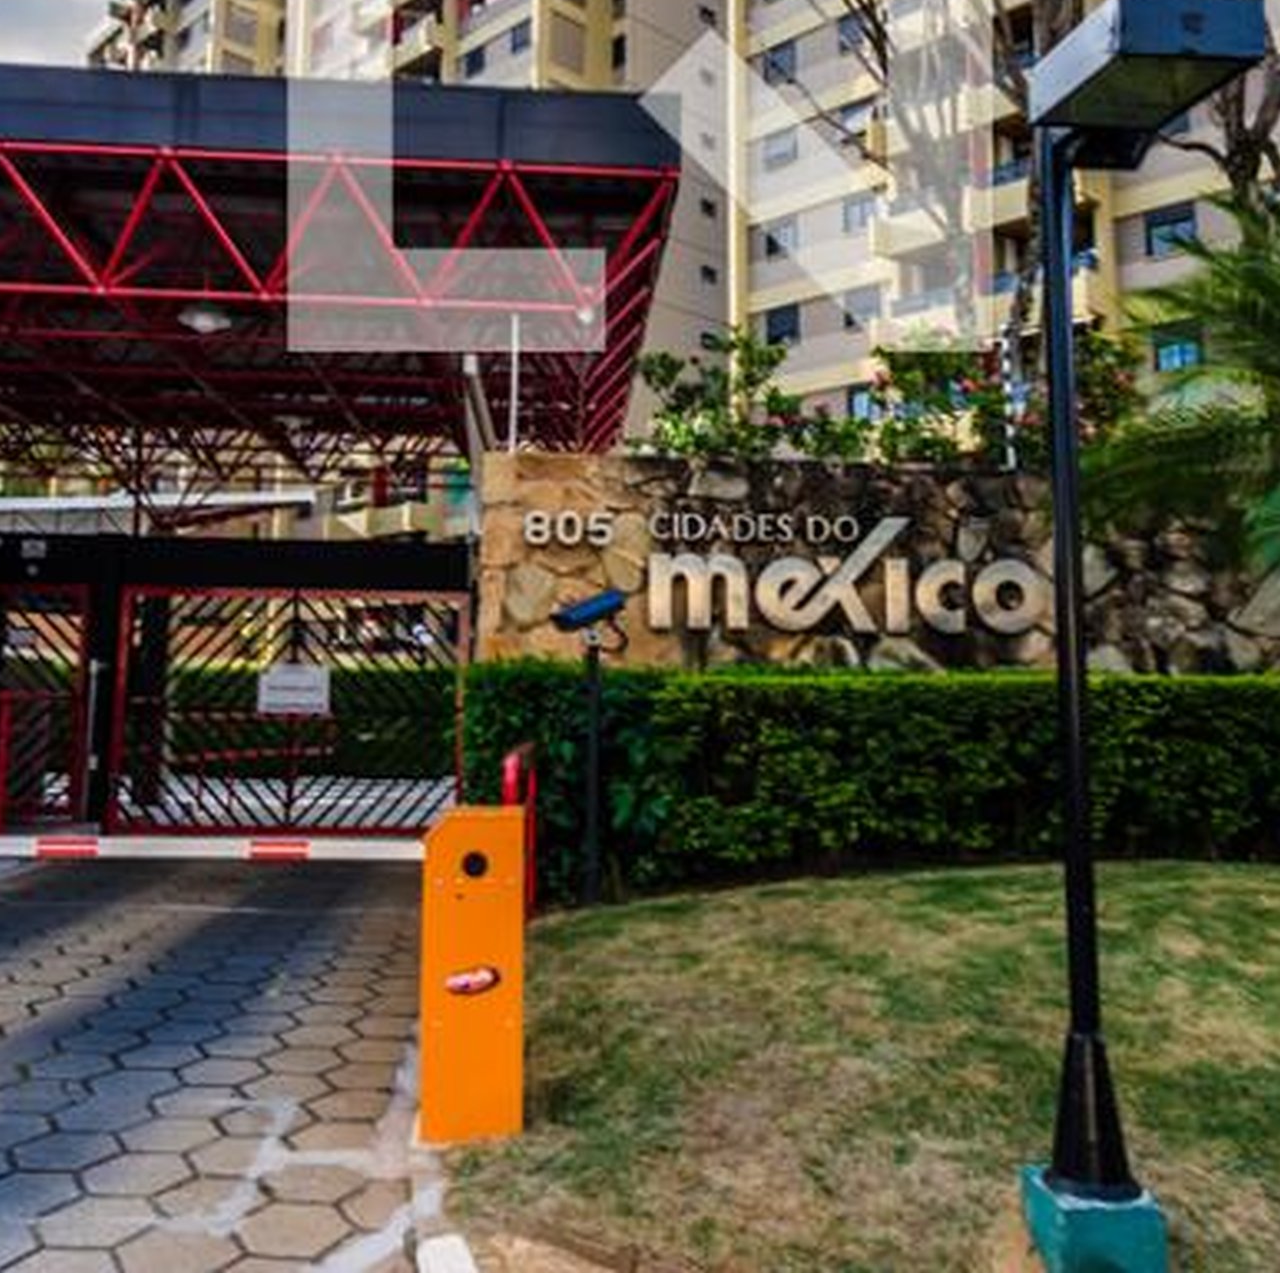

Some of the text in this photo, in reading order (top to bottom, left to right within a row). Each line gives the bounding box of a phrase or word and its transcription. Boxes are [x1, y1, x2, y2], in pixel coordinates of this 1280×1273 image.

[524, 510, 614, 546] 805
[649, 512, 859, 543] CIDADES DO
